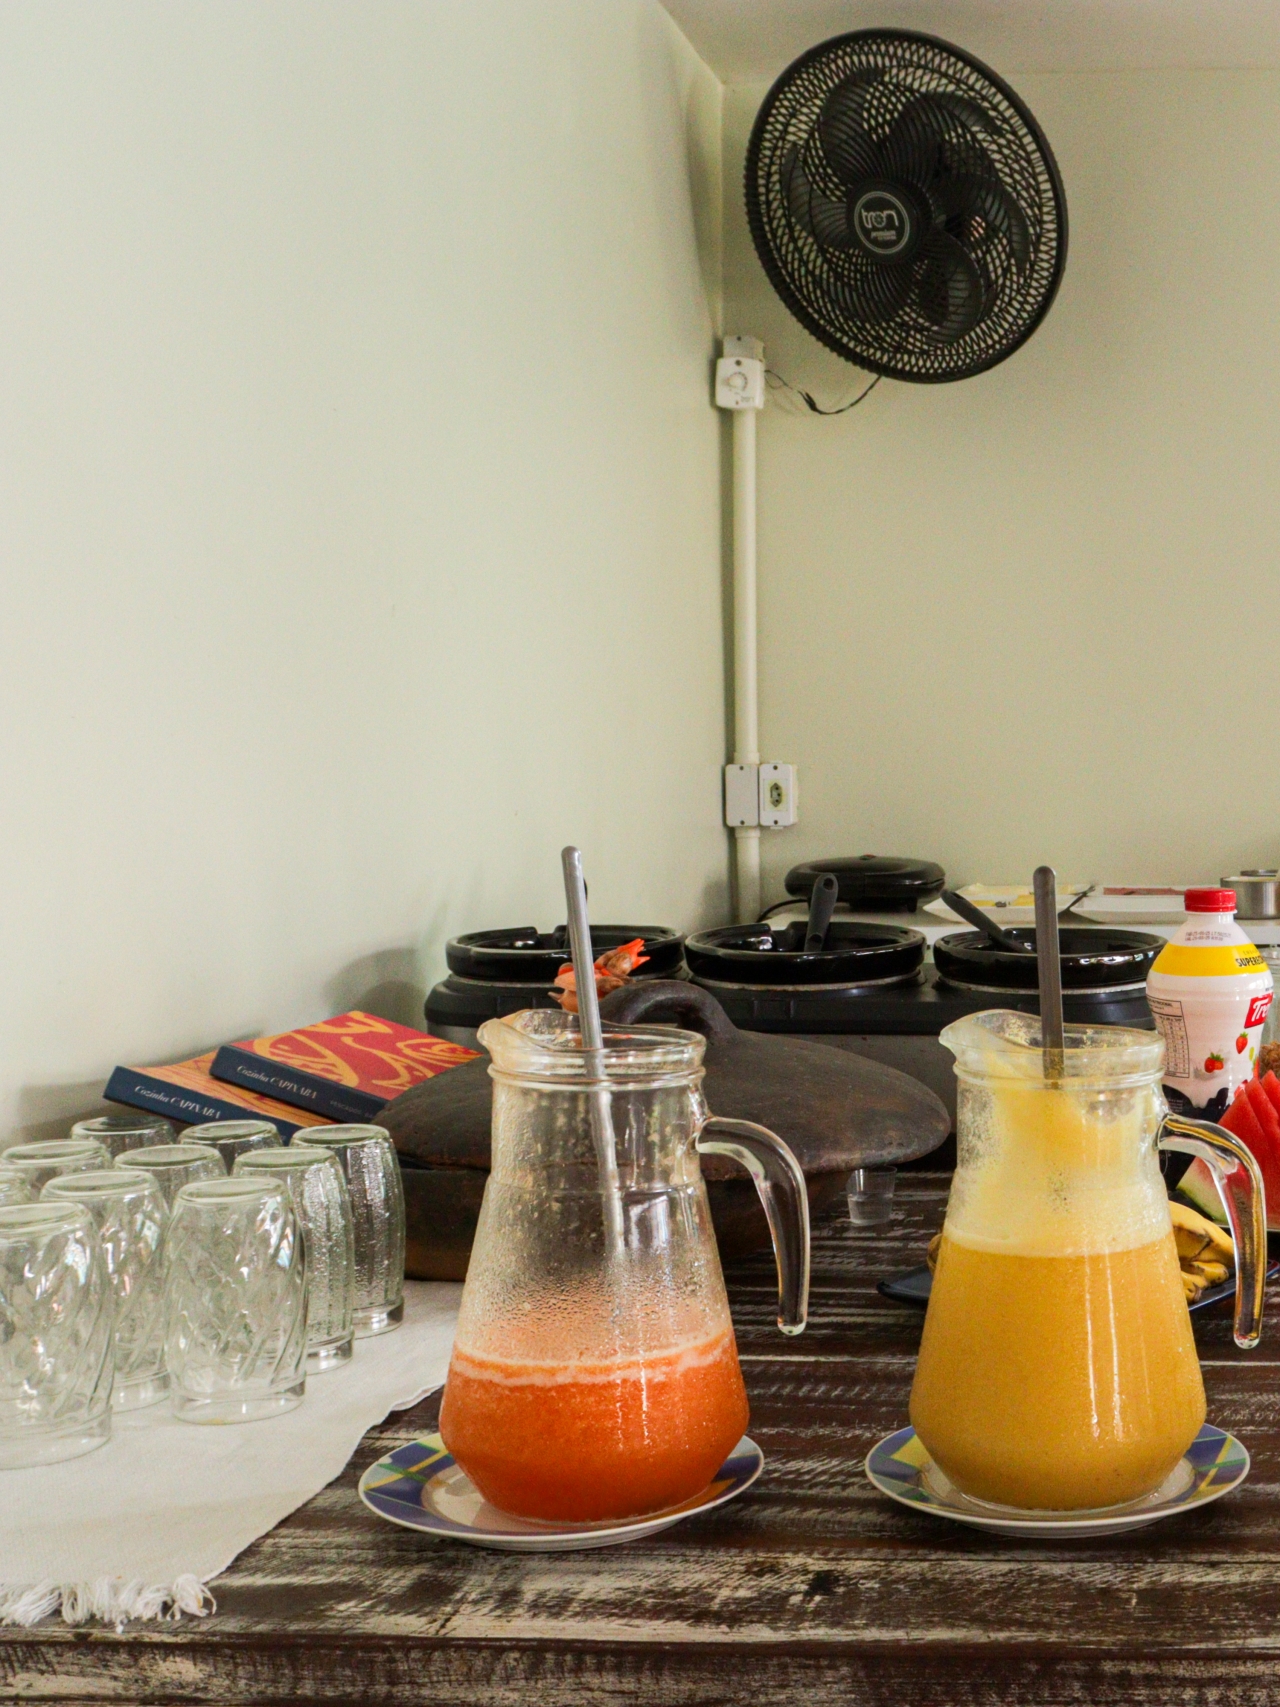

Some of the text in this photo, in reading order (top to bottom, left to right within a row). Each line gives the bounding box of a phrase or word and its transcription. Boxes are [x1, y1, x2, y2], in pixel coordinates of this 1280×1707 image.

[236, 1065, 269, 1083] Cozinha
[269, 1077, 318, 1100] CAPIXABA
[134, 1085, 221, 1119] Cozinha CAPIXABA
